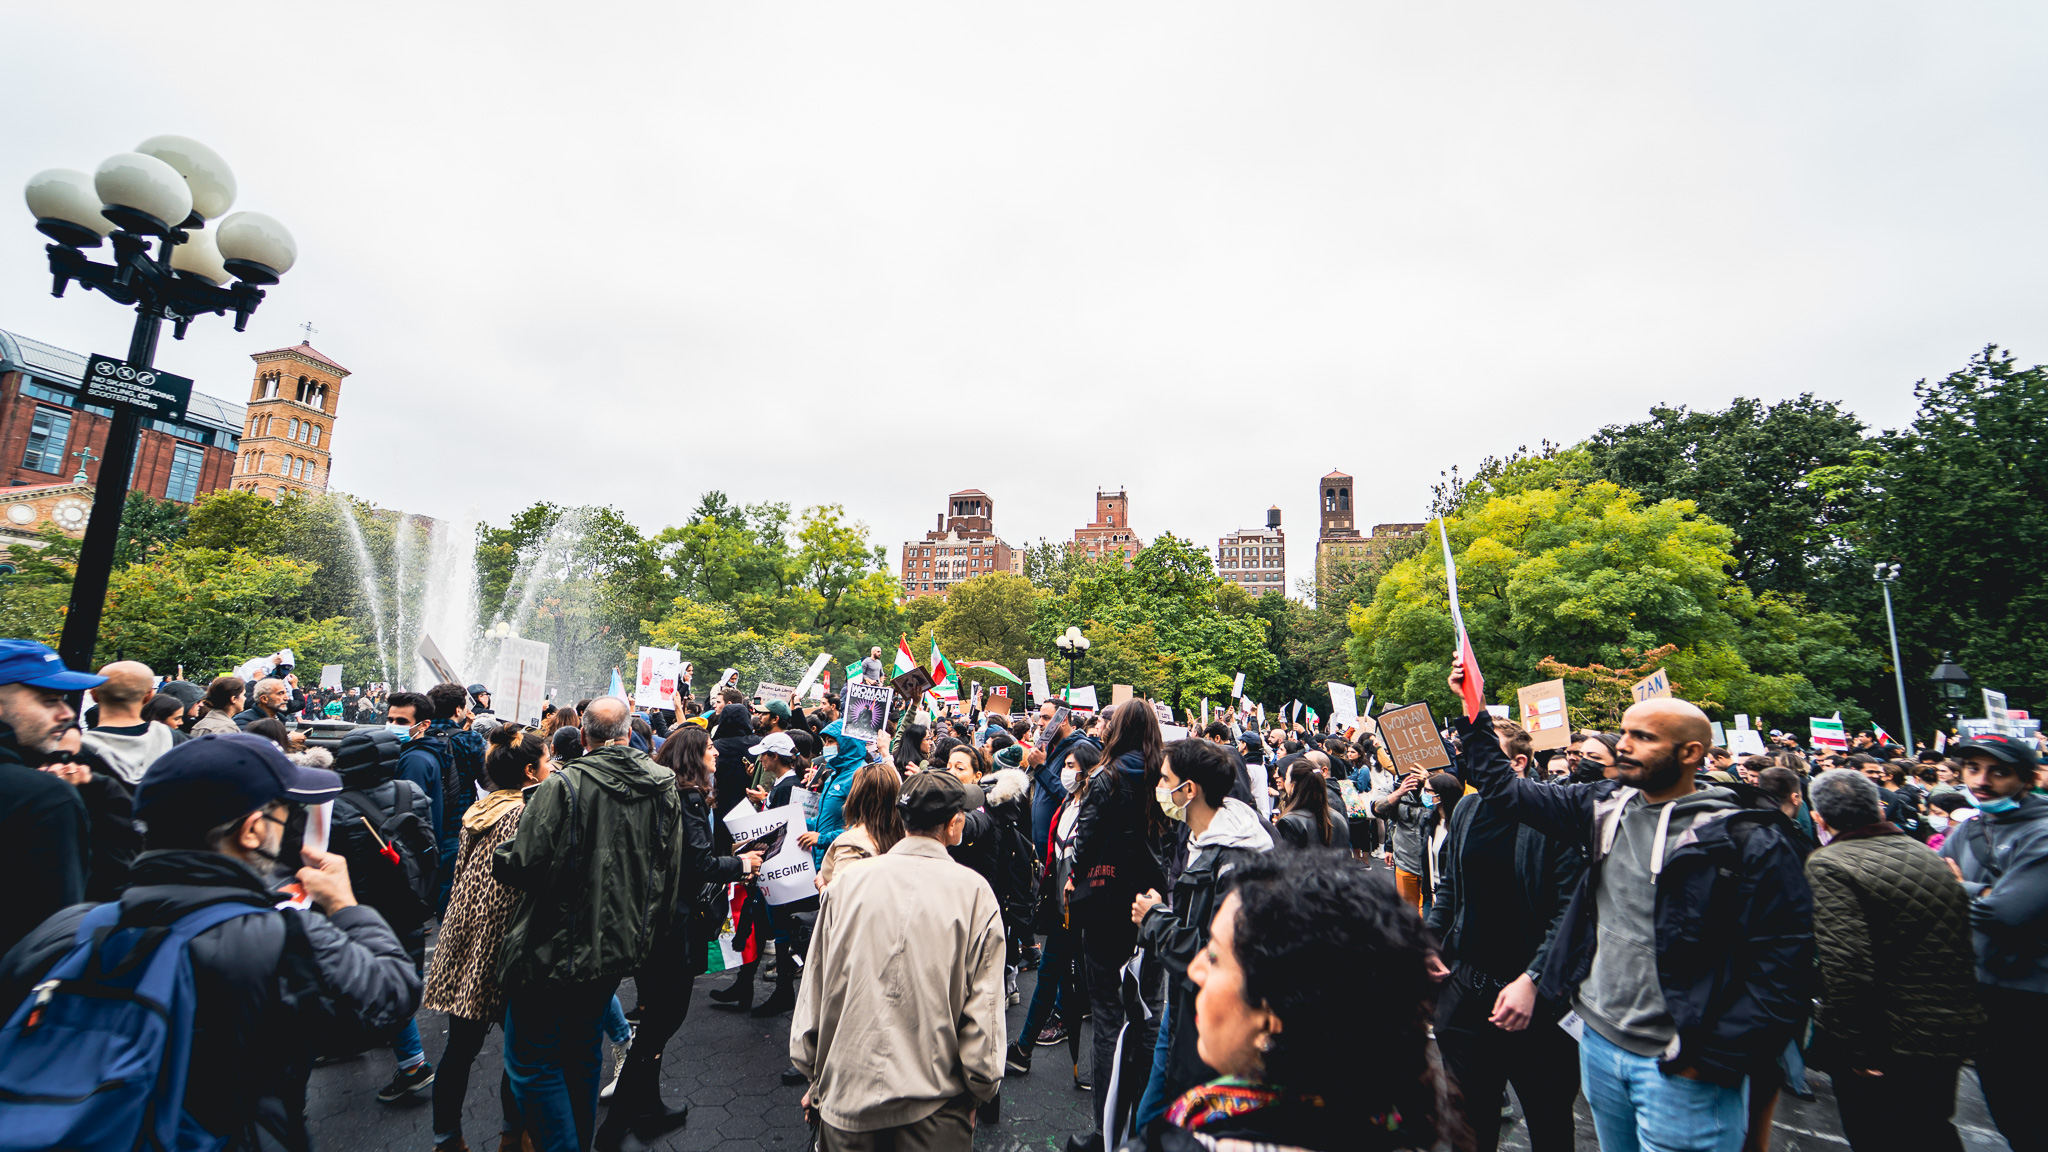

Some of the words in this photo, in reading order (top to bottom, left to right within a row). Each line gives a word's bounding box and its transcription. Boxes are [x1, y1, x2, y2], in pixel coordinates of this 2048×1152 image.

[87, 388, 128, 403] SCOOTER
[128, 397, 158, 410] RIDING
[89, 382, 136, 398] BICYCLING,
[137, 393, 151, 401] OR
[91, 375, 106, 384] NO
[105, 378, 177, 403] SKATEBOARDING,
[851, 684, 889, 698] WOMAN
[1637, 674, 1663, 701] ZAN
[1383, 708, 1425, 731] WOMAN
[1391, 723, 1435, 751] LIFE
[1396, 744, 1447, 766] FREEDOM
[767, 861, 809, 881] REGIME
